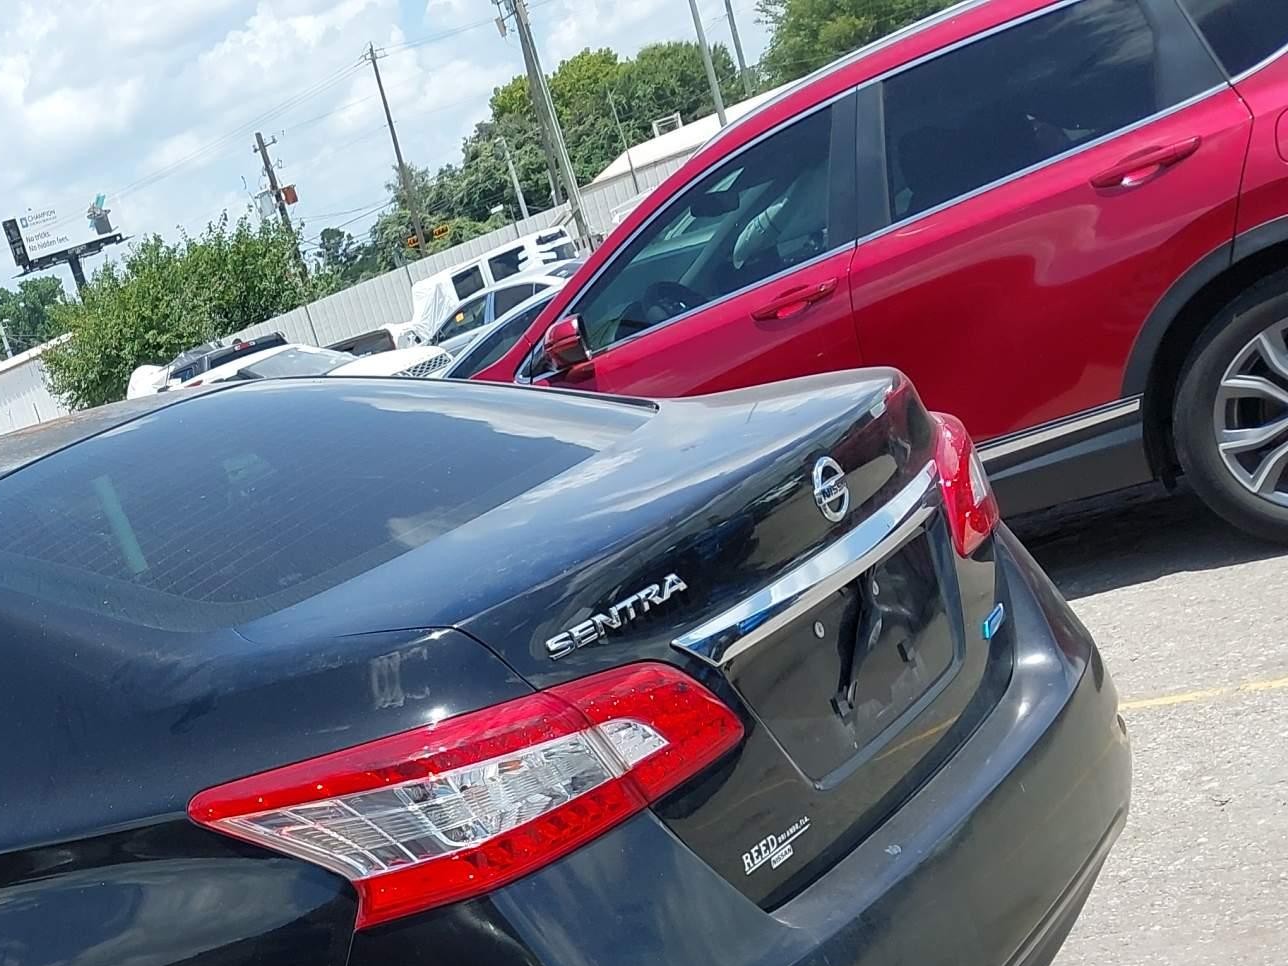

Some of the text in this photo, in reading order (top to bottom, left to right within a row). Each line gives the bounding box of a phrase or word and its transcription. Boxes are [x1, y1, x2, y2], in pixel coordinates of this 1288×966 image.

[38, 239, 56, 250] hidden
[545, 573, 688, 661] SENTRA
[742, 834, 778, 872] REED
[772, 847, 793, 866] NISSAN
